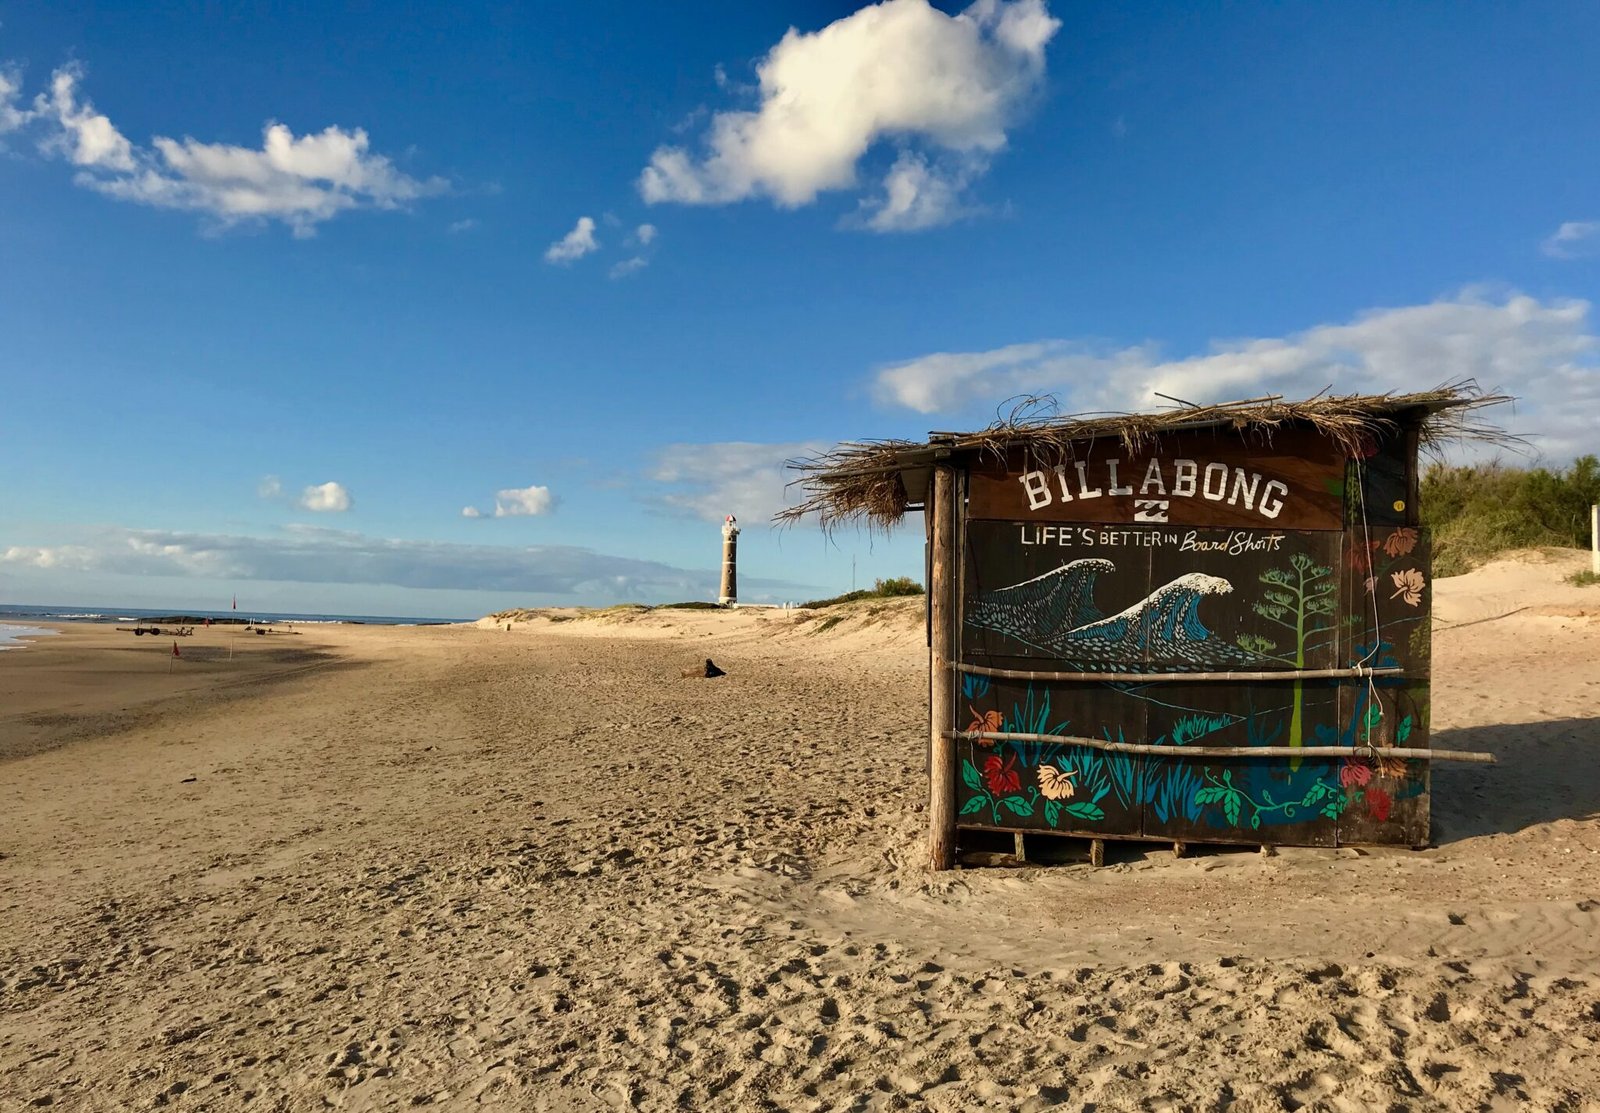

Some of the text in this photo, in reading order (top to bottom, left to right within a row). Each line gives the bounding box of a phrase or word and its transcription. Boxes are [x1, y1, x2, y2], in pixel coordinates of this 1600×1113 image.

[1019, 458, 1289, 519] BILLABONG
[1021, 526, 1096, 546] LIFE'S
[1100, 531, 1162, 547] BETTER
[1164, 533, 1178, 545] IN
